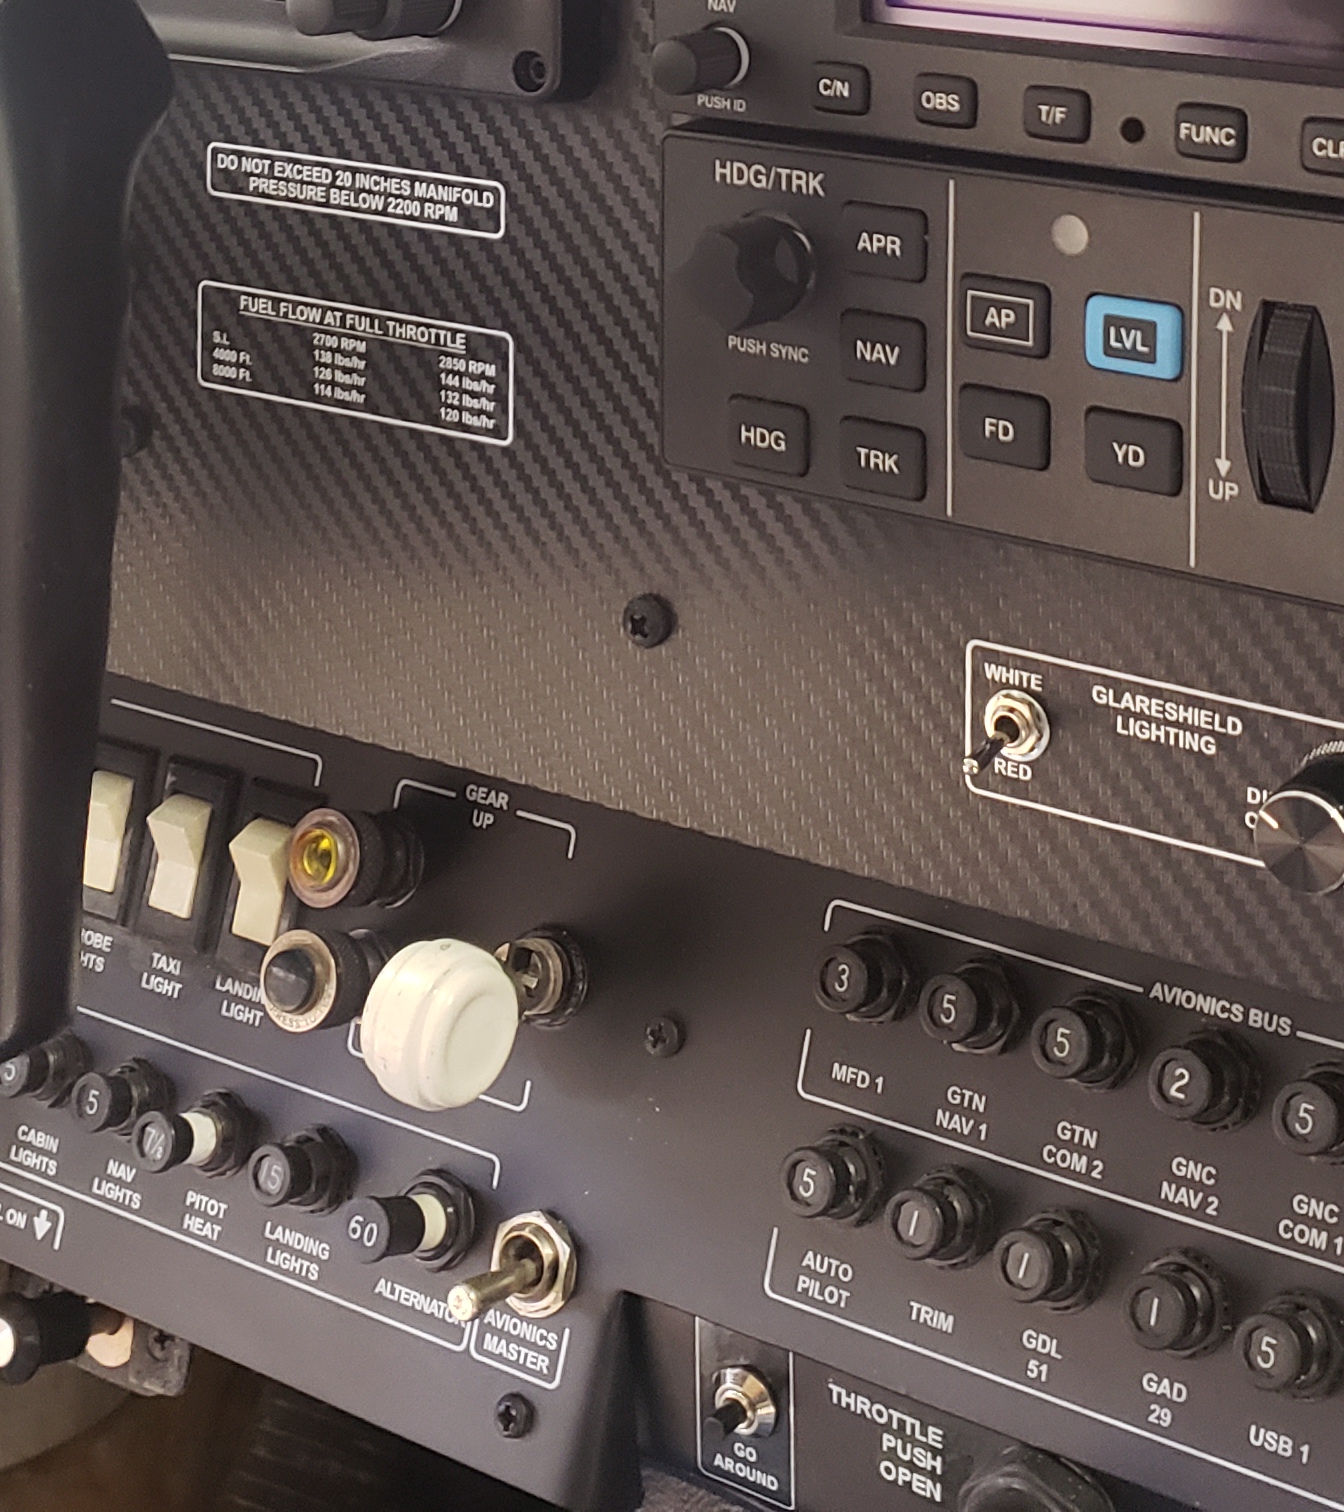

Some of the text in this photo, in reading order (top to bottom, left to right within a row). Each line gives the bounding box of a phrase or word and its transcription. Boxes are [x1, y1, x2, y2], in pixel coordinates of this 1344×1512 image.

[818, 78, 850, 99] C/N
[921, 91, 960, 112] OBS
[697, 95, 747, 113] PUSH ID
[1038, 104, 1067, 126] T/F
[1178, 123, 1236, 147] FUNC
[217, 153, 495, 208] DO NOT EXCEED 20 INCHES MANIFOLD
[714, 159, 826, 197] HDG/TRK
[249, 176, 459, 222] PRESSURE BELOW 2200 RPM
[857, 231, 902, 257] APR
[1209, 286, 1243, 313] DN
[239, 294, 467, 349] FUEL FLOW AT FULL THROTTLE
[985, 307, 1016, 330] AP
[312, 332, 367, 353] 2700 RPM
[728, 336, 810, 363] PUSH SYNC
[856, 339, 900, 366] NAV
[1109, 325, 1151, 354] LVL
[438, 355, 496, 377] 2850 RPM
[313, 382, 333, 398] 114
[439, 372, 496, 394] 144 lbs/hr
[439, 389, 496, 412] 132 lbs/hr
[439, 406, 496, 429] 120 lbs/hr
[984, 418, 1015, 443] FD
[740, 423, 787, 452] HDG
[856, 447, 900, 474] TRK
[1112, 442, 1146, 468] YD
[1208, 480, 1239, 502] UP
[983, 662, 1043, 692] WHITE
[1092, 685, 1243, 737] GLARESHIELD
[1116, 714, 1217, 756] LIGHTING
[993, 757, 1033, 781] RED
[465, 783, 509, 810] GEAR
[472, 809, 494, 829] UP
[151, 952, 182, 976] TAXI
[834, 964, 850, 993] 3
[141, 972, 183, 1000] LIGHT
[221, 999, 264, 1027] LIGHT
[940, 993, 957, 1024] 5
[1149, 981, 1293, 1037] AVIONICS BUS
[1053, 1027, 1071, 1057] 5
[831, 1062, 884, 1094] MFD 1
[1169, 1067, 1190, 1100] 2
[85, 1090, 101, 1116] 5
[946, 1085, 987, 1113] GTN
[935, 1108, 988, 1141] NAV 1
[1295, 1102, 1317, 1135] 5
[17, 1125, 59, 1153] CABIN
[1056, 1120, 1098, 1149] GTN
[9, 1144, 58, 1176] LIGHTS
[106, 1158, 136, 1183] NAV
[1042, 1144, 1104, 1180] COM 2
[1171, 1156, 1217, 1185] GNC
[259, 1160, 283, 1191] 15
[798, 1167, 817, 1197] 5
[91, 1177, 142, 1209] LIGHTS
[185, 1190, 228, 1219] PITOT
[1160, 1181, 1220, 1216] NAV 2
[6, 1207, 27, 1230] ON
[1292, 1193, 1340, 1224] GNC
[182, 1214, 222, 1242] HEAT
[264, 1221, 330, 1260] LANDING
[348, 1215, 378, 1247] 60
[1278, 1218, 1344, 1256] COM 1
[266, 1246, 320, 1281] LIGHTS
[801, 1249, 854, 1283] AUTO
[796, 1275, 851, 1309] PILOT
[484, 1308, 558, 1351] AVIONICS
[909, 1300, 955, 1334] TRIM
[483, 1332, 551, 1375] MASTER
[1022, 1328, 1063, 1360] GDL
[1257, 1336, 1277, 1369] 5
[1026, 1360, 1048, 1383] 51
[1141, 1371, 1187, 1403] GAD
[828, 1381, 944, 1450] THROTTLE
[1147, 1404, 1172, 1428] 29
[733, 1442, 757, 1462] GO
[882, 1433, 943, 1475] PUSH
[1248, 1424, 1311, 1464] USB 1
[713, 1452, 779, 1492] AROUND
[878, 1460, 943, 1503] OPEN
